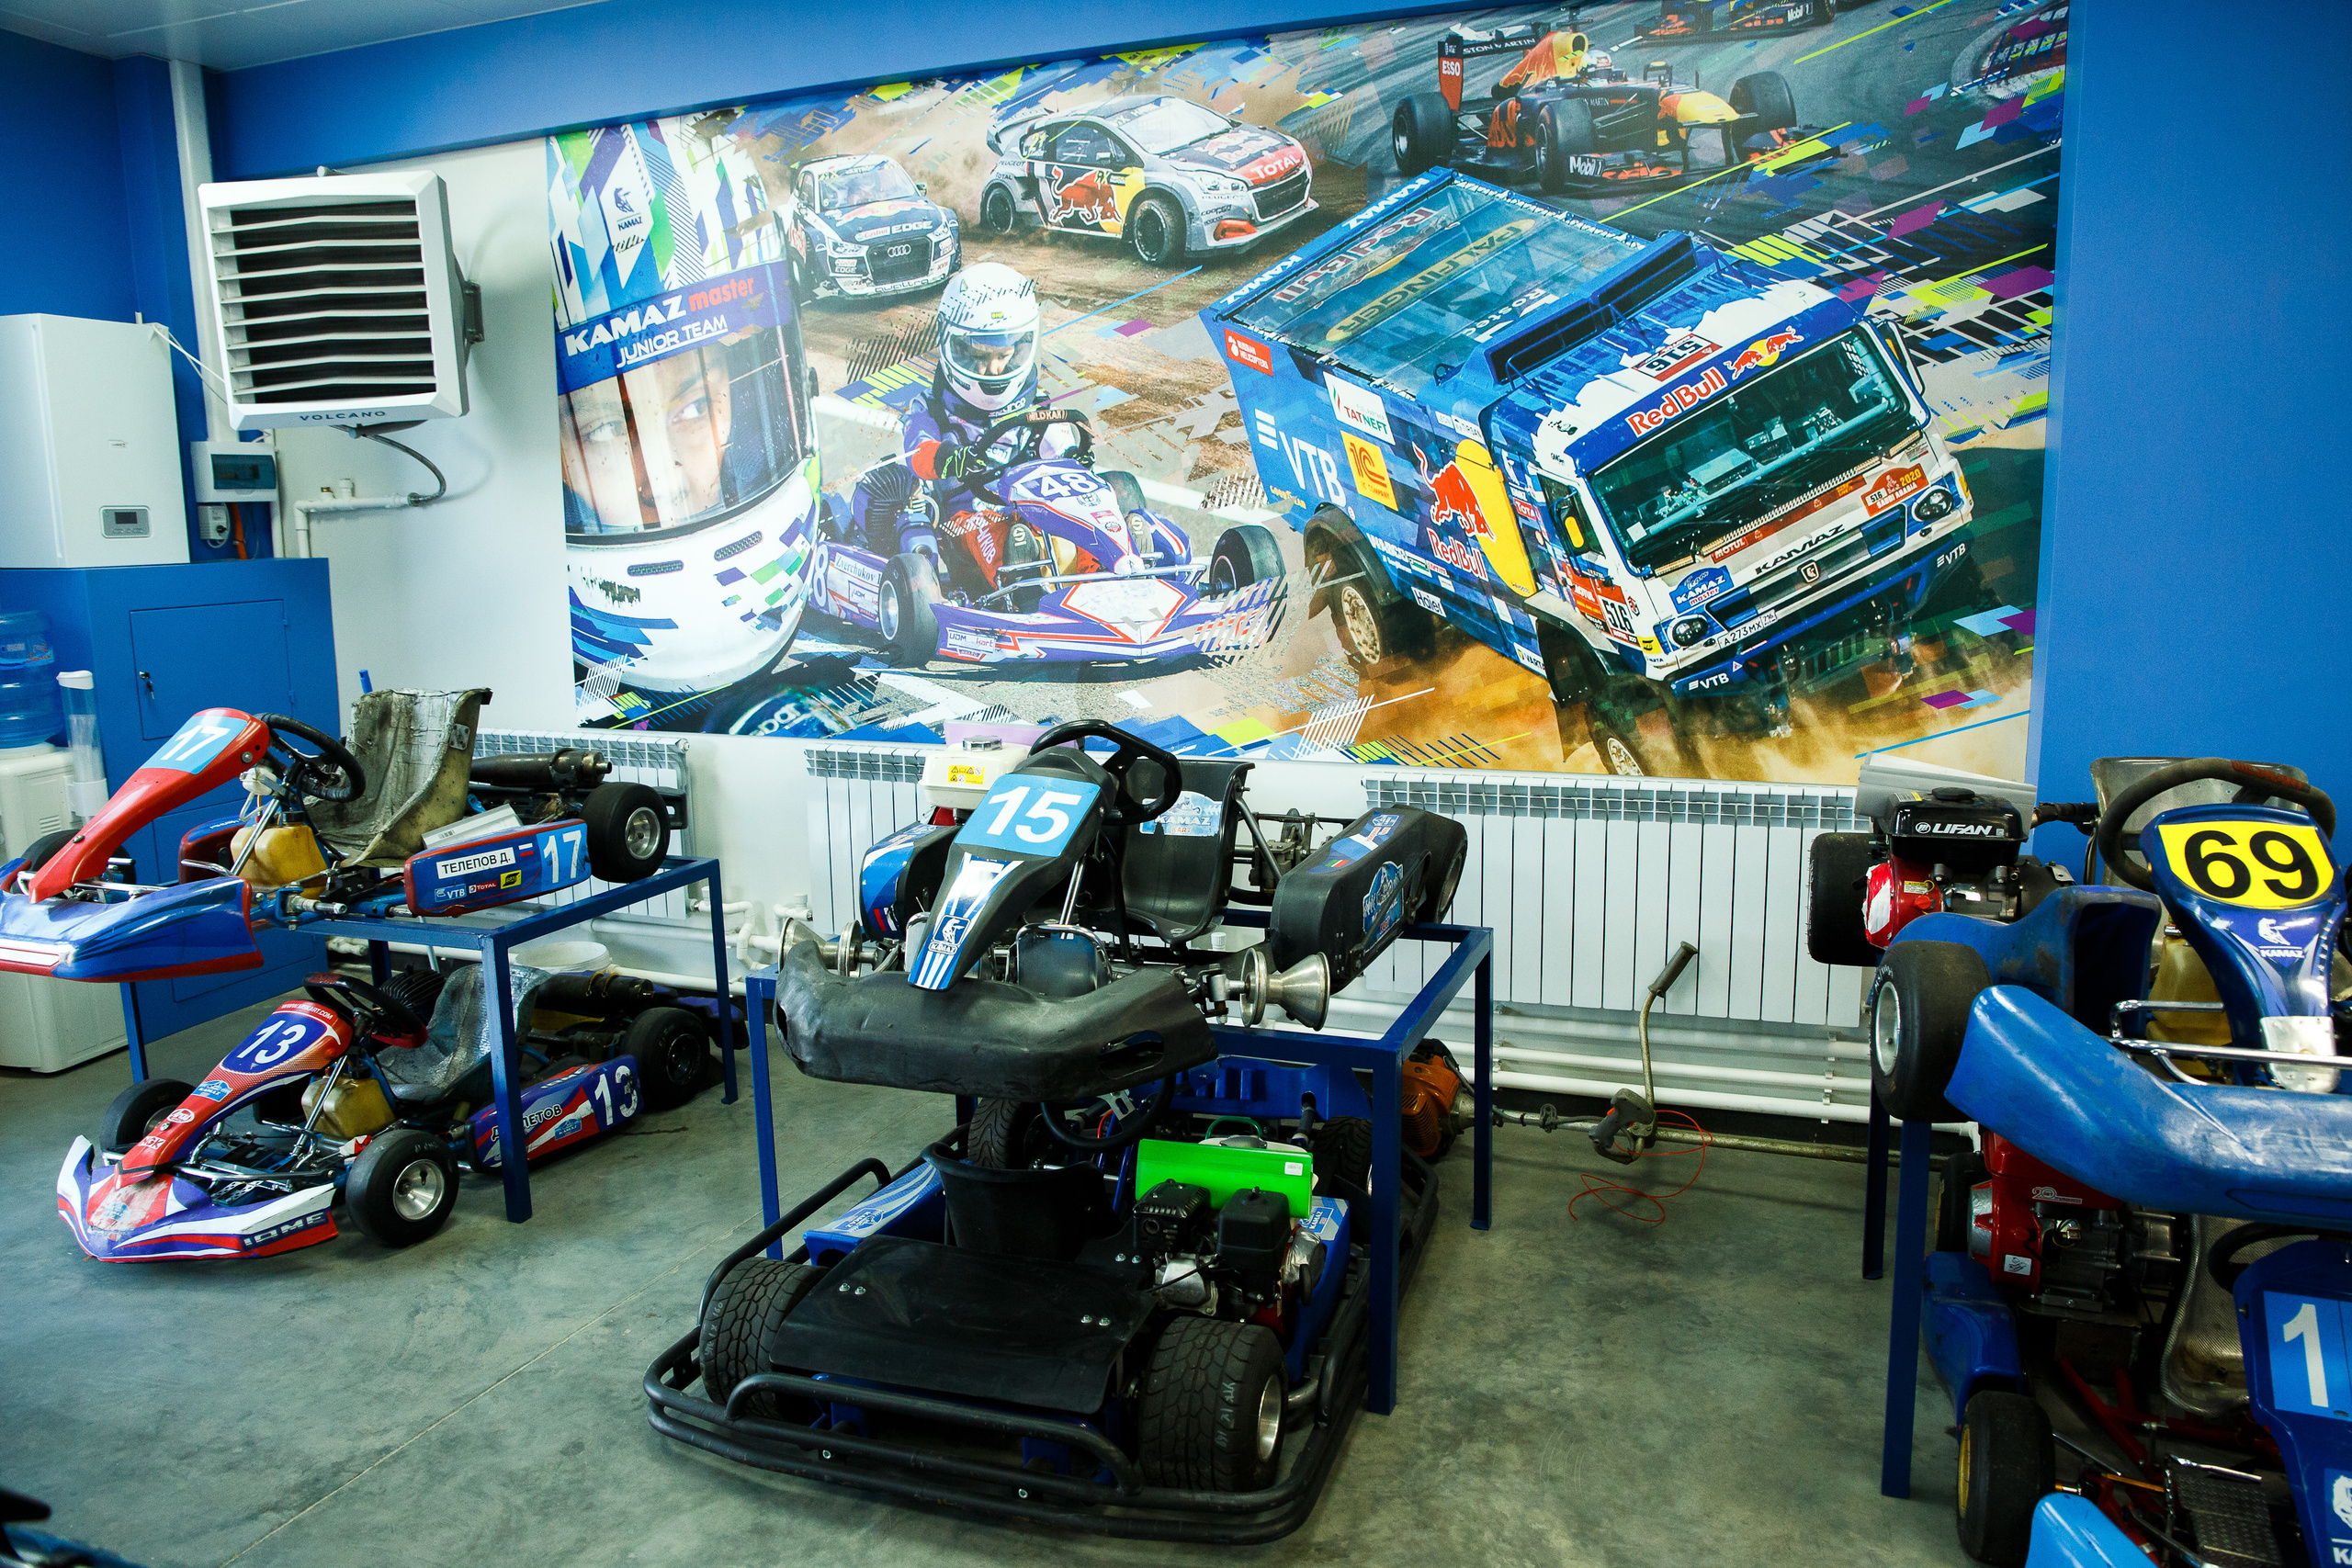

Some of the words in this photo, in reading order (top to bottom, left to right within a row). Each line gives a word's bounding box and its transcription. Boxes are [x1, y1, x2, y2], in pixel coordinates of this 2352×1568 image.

[1787, 3, 1804, 22] Mobil
[1463, 45, 1493, 54] STON
[1442, 60, 1461, 76] ESSO
[996, 172, 1013, 180] TOTAL
[1250, 154, 1300, 178] TOTAL
[1569, 156, 1596, 176] Mobil
[1341, 176, 1430, 231] KAMAZ
[617, 216, 643, 231] KAMAZ
[891, 220, 933, 235] EDGE
[875, 278, 929, 293] quattro
[1220, 254, 1303, 305] KAMAZ
[1337, 226, 1522, 333] PALFINGER
[564, 295, 686, 357] KAMAZ
[689, 277, 754, 312] master
[1462, 287, 1546, 337] Rostec
[616, 330, 679, 369] JUNIOR
[682, 314, 728, 338] TEAM
[1239, 350, 1270, 370] HELICOPTERS
[1645, 340, 1704, 372] 516
[1625, 393, 1681, 438] Red
[1671, 367, 1728, 411] Bull
[300, 411, 386, 421] VOLCANO
[1344, 405, 1388, 435] TATNEFT
[1279, 431, 1347, 508] VTB
[1040, 472, 1099, 498] 48
[1870, 491, 1883, 504] 516
[1899, 468, 1922, 488] 2020
[1876, 492, 1895, 510] SAUDI
[1894, 481, 1918, 499] ARABIA
[1427, 527, 1459, 568] Red
[1456, 539, 1488, 582] Bull
[1714, 538, 1746, 559] MOTUL
[1754, 524, 1846, 575] KAMAZ
[1945, 543, 1966, 565] VTB
[812, 545, 829, 607] 8
[836, 555, 876, 582] Zverchukov
[1684, 570, 1710, 590] Team
[1676, 575, 1726, 605] KAMAZ
[1690, 586, 1720, 606] master
[1603, 599, 1634, 635] 516
[949, 632, 967, 641] UDM
[976, 637, 995, 648] kart
[1700, 672, 1730, 689] VTB
[160, 724, 231, 761] 17
[986, 785, 1082, 844] 15
[1155, 815, 1212, 826] KAMAZ
[1932, 823, 1993, 836] LIFAN
[442, 854, 497, 874] ТЕЛЕПОВ
[500, 852, 511, 864] Д.
[543, 829, 582, 885] 17
[2185, 829, 2319, 900] 69
[447, 888, 466, 900] VTB
[476, 882, 497, 892] TOTAL
[929, 942, 957, 954] KAMAZ
[2259, 948, 2306, 959] KAMAZ
[236, 1020, 307, 1064] 13
[594, 1065, 639, 1126] 13
[141, 1136, 165, 1149] NGK
[2283, 1303, 2329, 1408] 1
